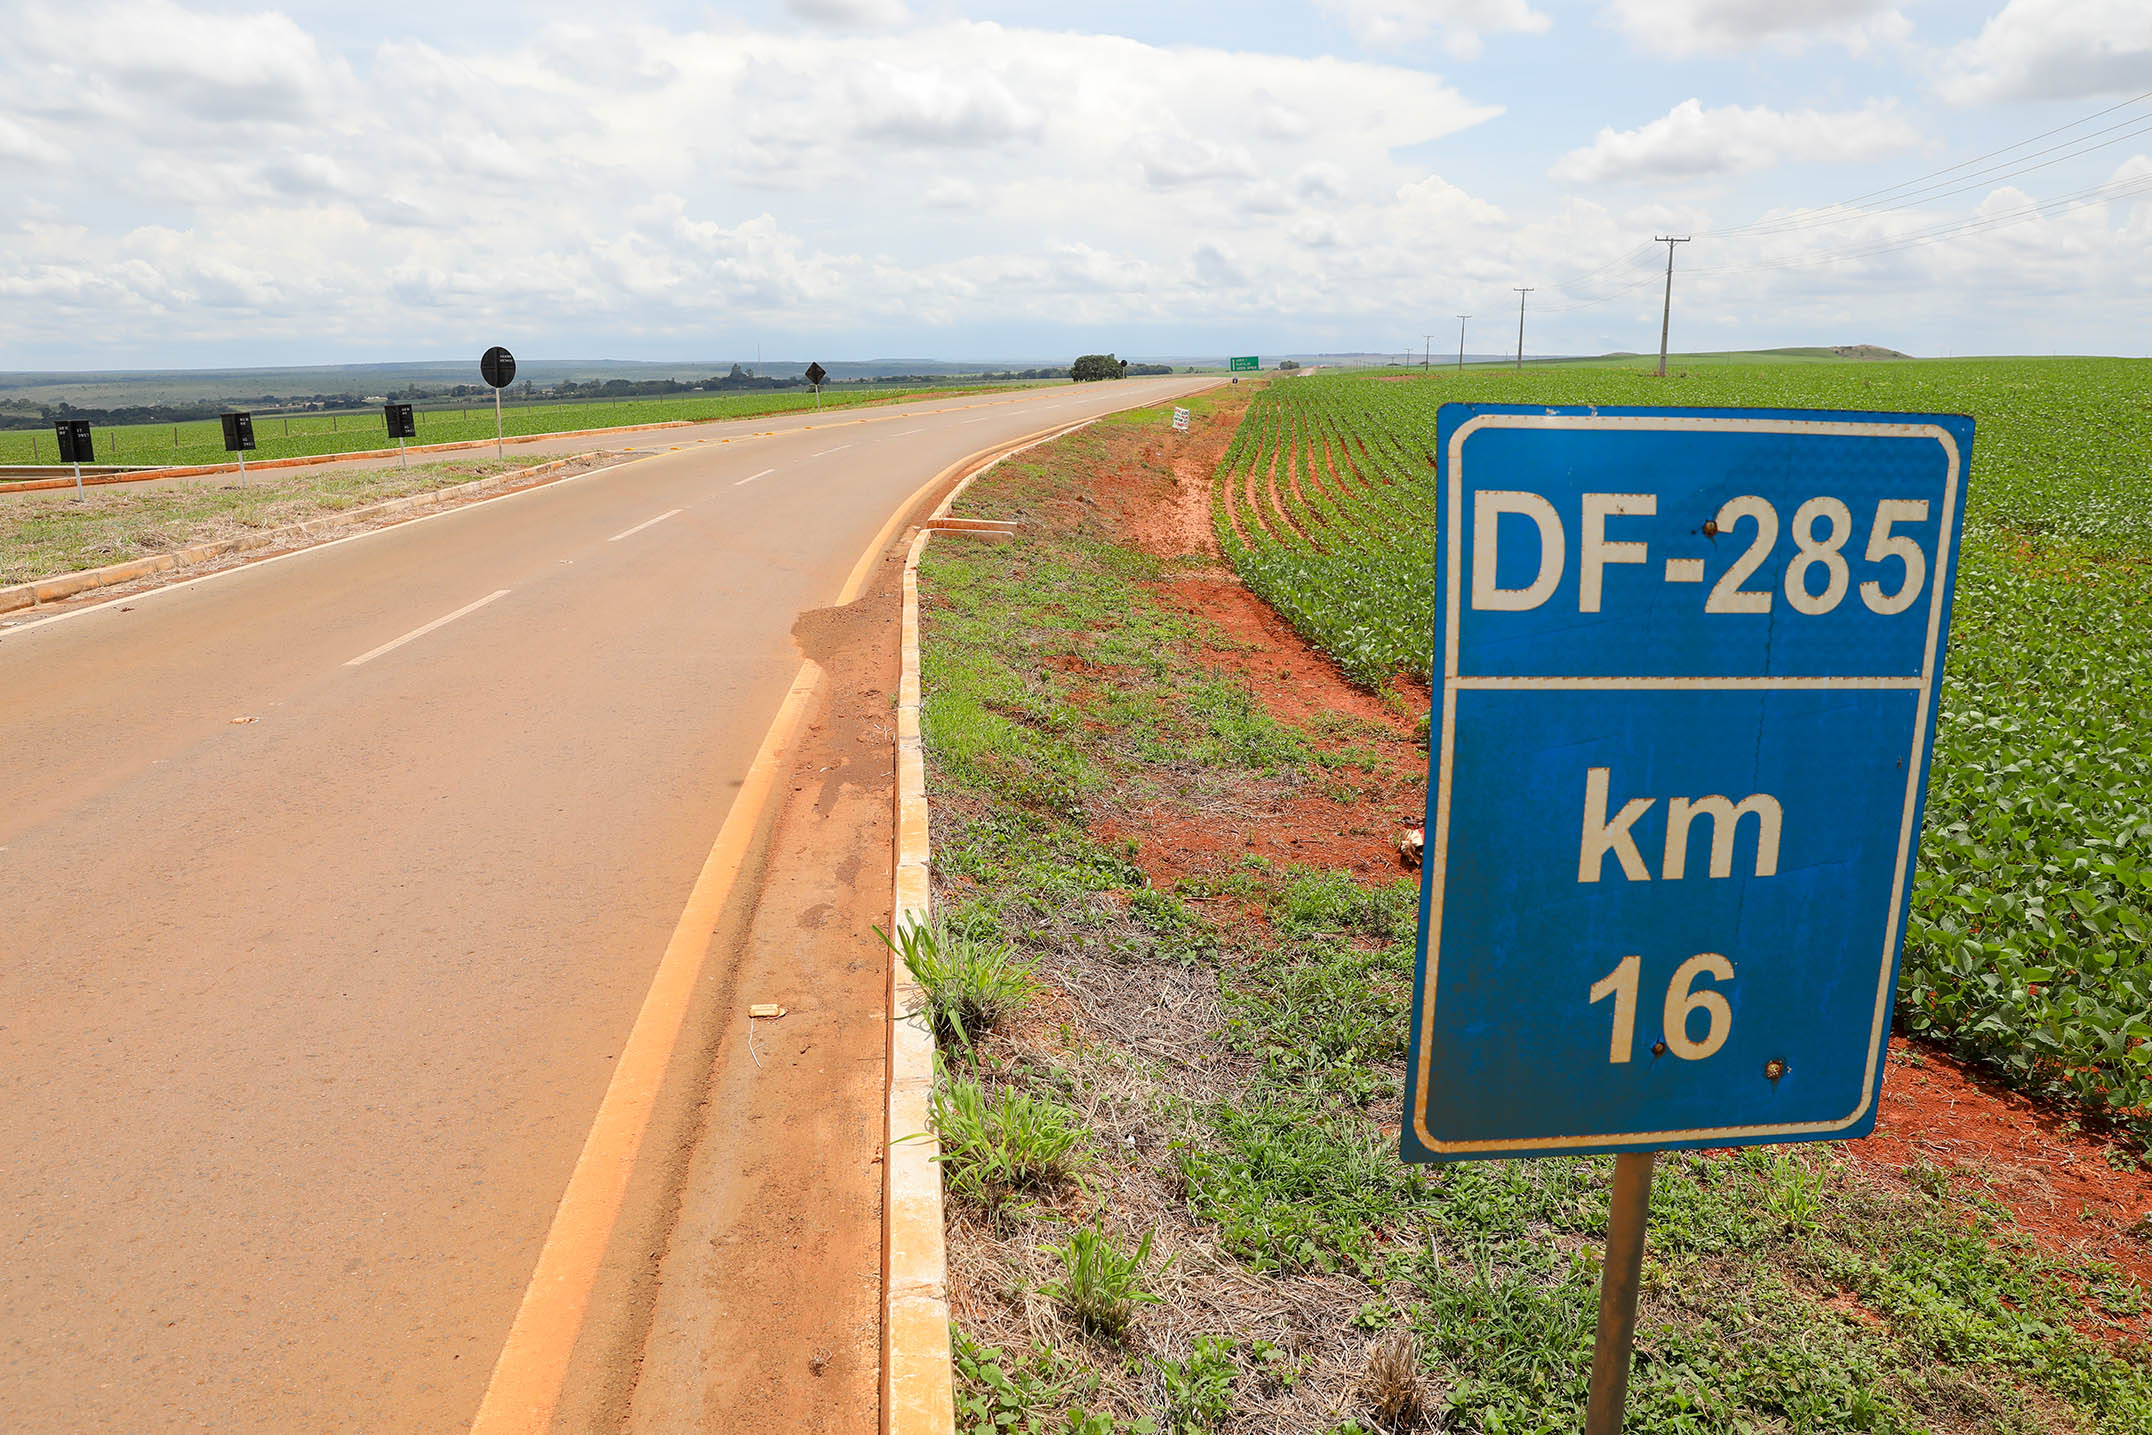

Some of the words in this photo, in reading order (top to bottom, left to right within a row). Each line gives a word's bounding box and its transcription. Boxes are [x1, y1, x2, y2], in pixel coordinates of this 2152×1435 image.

[1471, 490, 1930, 615] DF-285
[1577, 767, 1784, 883] km
[1589, 953, 1735, 1063] 16
